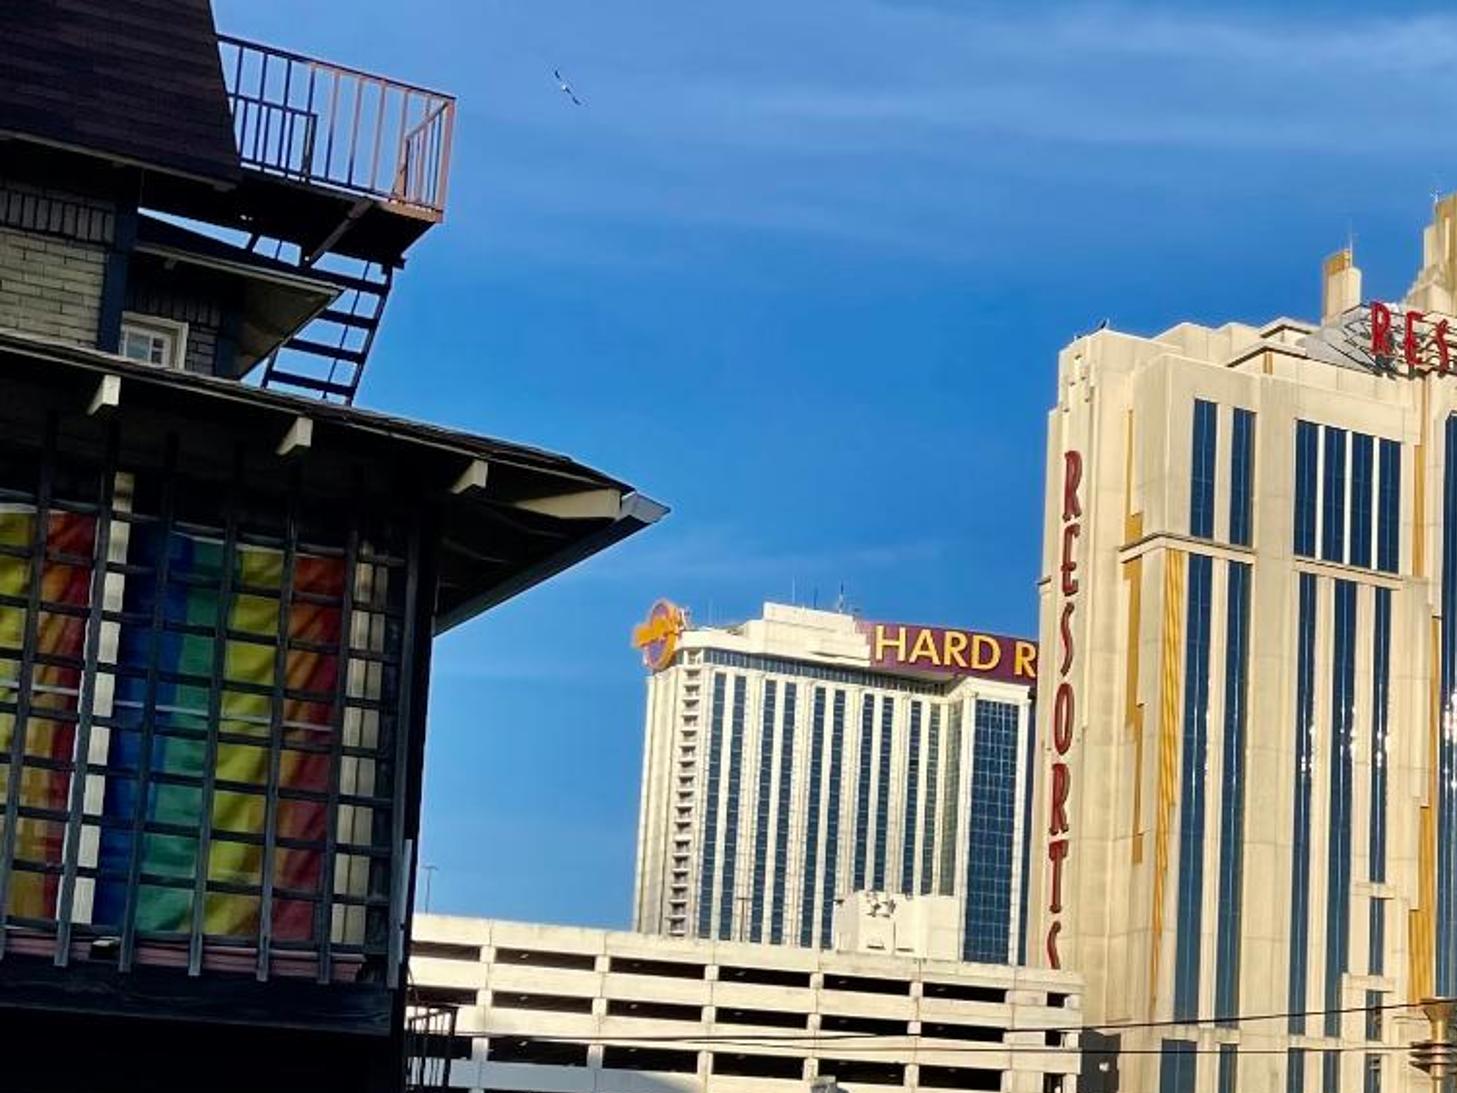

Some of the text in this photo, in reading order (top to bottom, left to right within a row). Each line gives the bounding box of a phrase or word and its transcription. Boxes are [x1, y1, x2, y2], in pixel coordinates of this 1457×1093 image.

[875, 627, 1037, 678] HARD R
[1047, 449, 1082, 969] RESORTS
